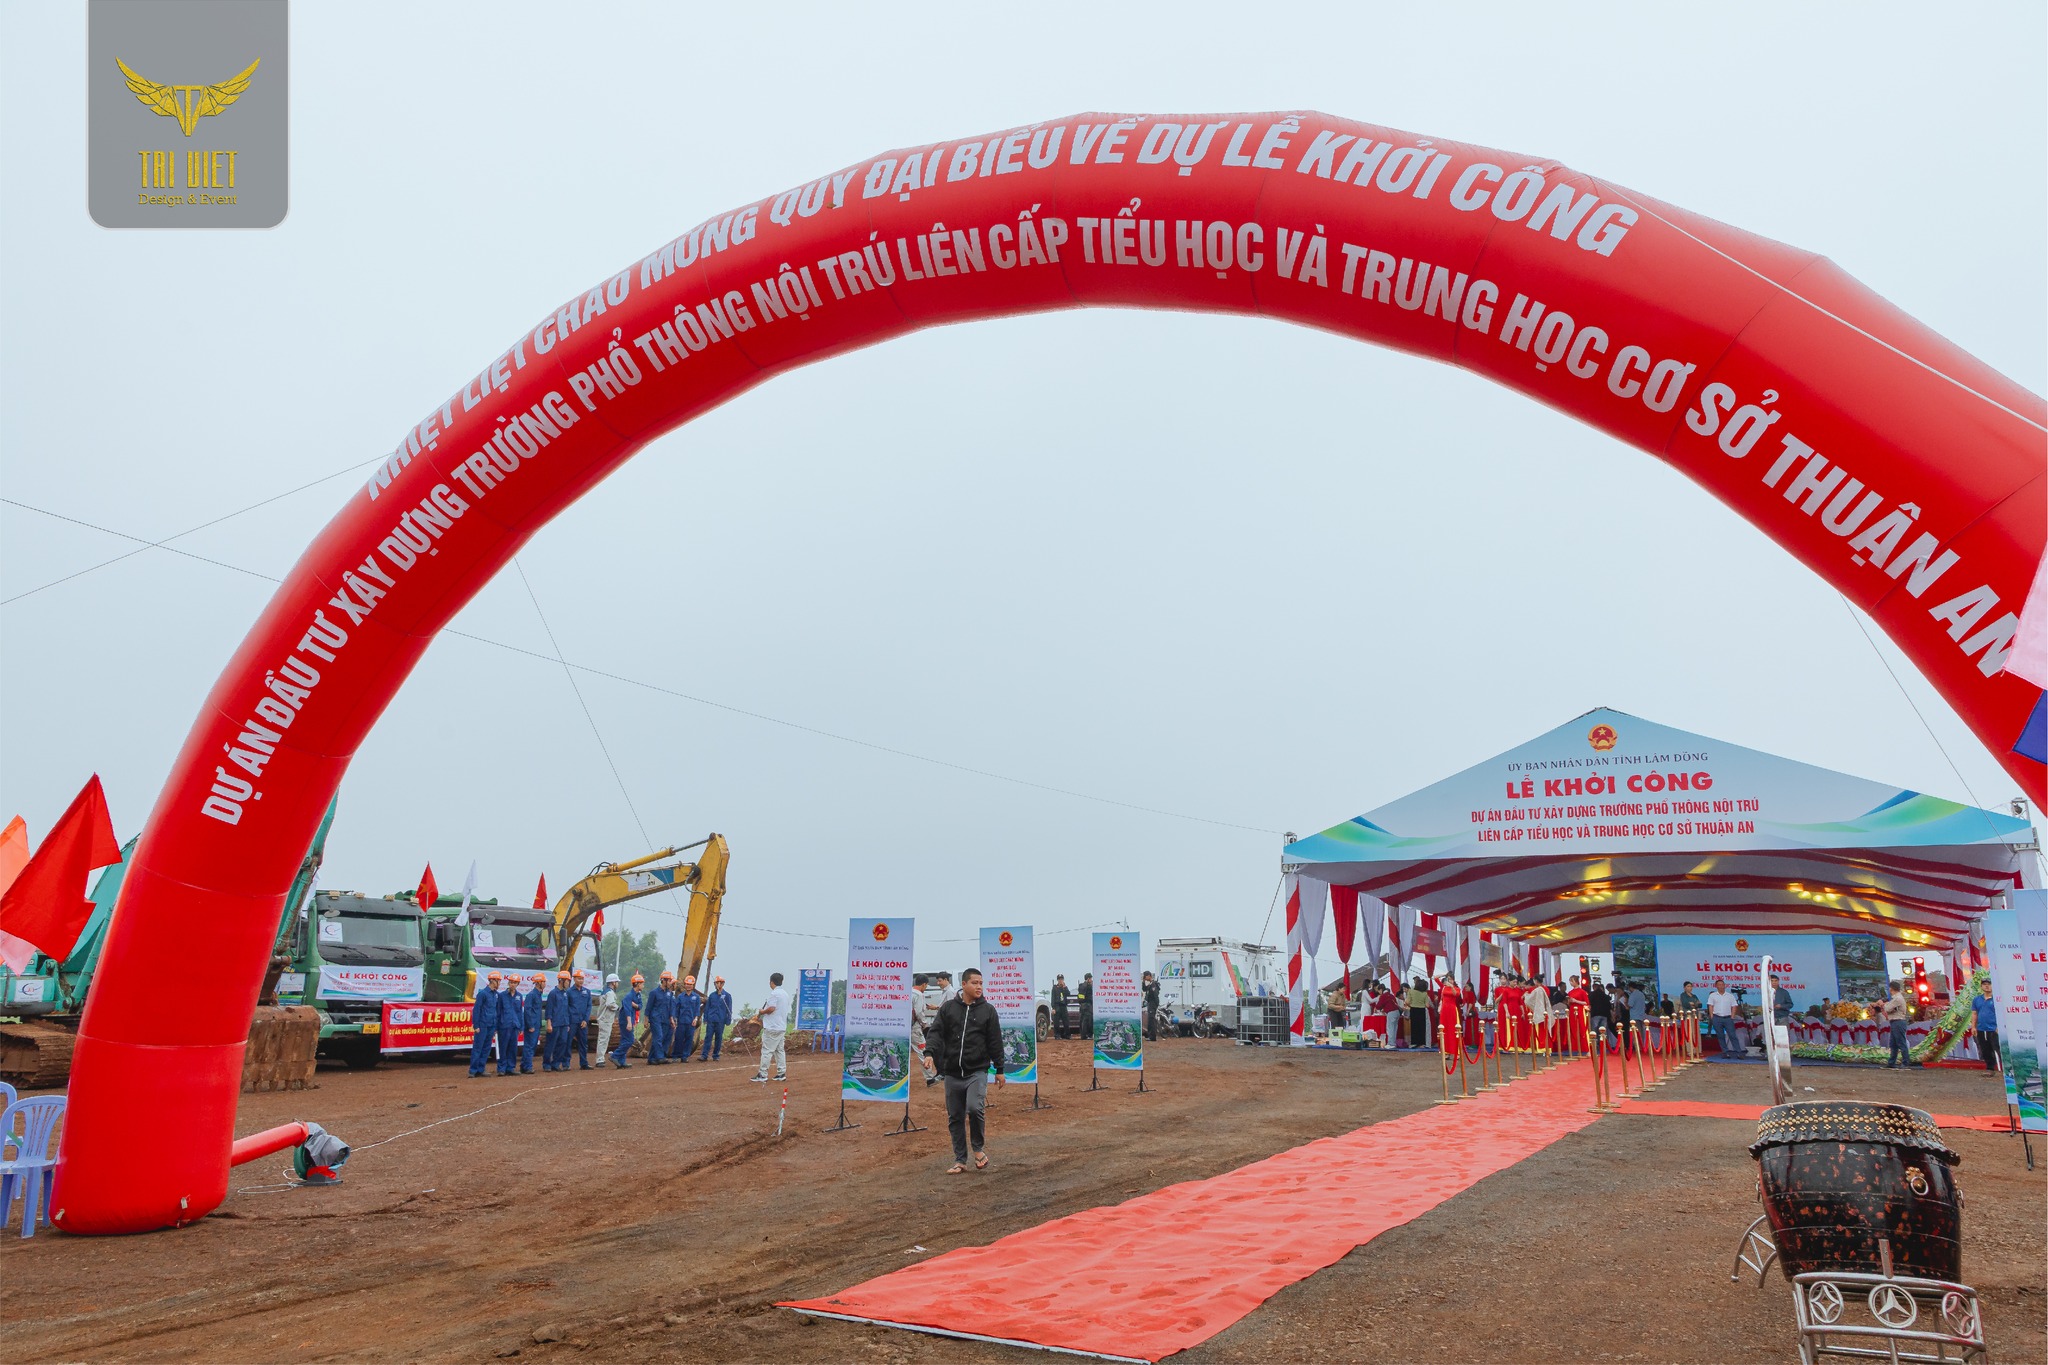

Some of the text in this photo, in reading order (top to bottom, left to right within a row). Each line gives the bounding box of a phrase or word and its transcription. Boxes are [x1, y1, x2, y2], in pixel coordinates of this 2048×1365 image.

[863, 149, 943, 202] ĐẠI
[1136, 121, 1230, 177] DỰ
[1222, 115, 1305, 170] LỄ
[1296, 131, 1452, 199] KHỞI
[1449, 163, 1639, 257] CÔNG
[201, 197, 2020, 826] DỰ ÁN ĐẦU TƯ XÂY DỰNG TRƯỜNG PHỔ THÔNG NỘI TRÚ LIÊN CẤP TIỂU HỌC VÀ TRUNG HỌC CƠ SỞ THUẬN AN
[1525, 761, 1547, 771] BAN
[1550, 758, 1582, 769] NHÂN
[1585, 756, 1609, 766] DÂN
[1645, 753, 1670, 763] LÂM
[1506, 770, 1713, 799] LỄ KHỞI CÔNG
[1471, 796, 1759, 825] DỰ ÁN ĐẦU TƯ XÂY DỰNG TRƯỜNG PHỔ THÔNG NỘI TRÚ
[1478, 819, 1755, 842] LIÊN CẤP TIỂU HỌC VÀ TRUNG HỌC CƠ SỞ THUẬN AN
[1192, 964, 1210, 975] HD
[1715, 961, 1749, 972] KHỞI
[444, 1008, 471, 1022] KHỞI
